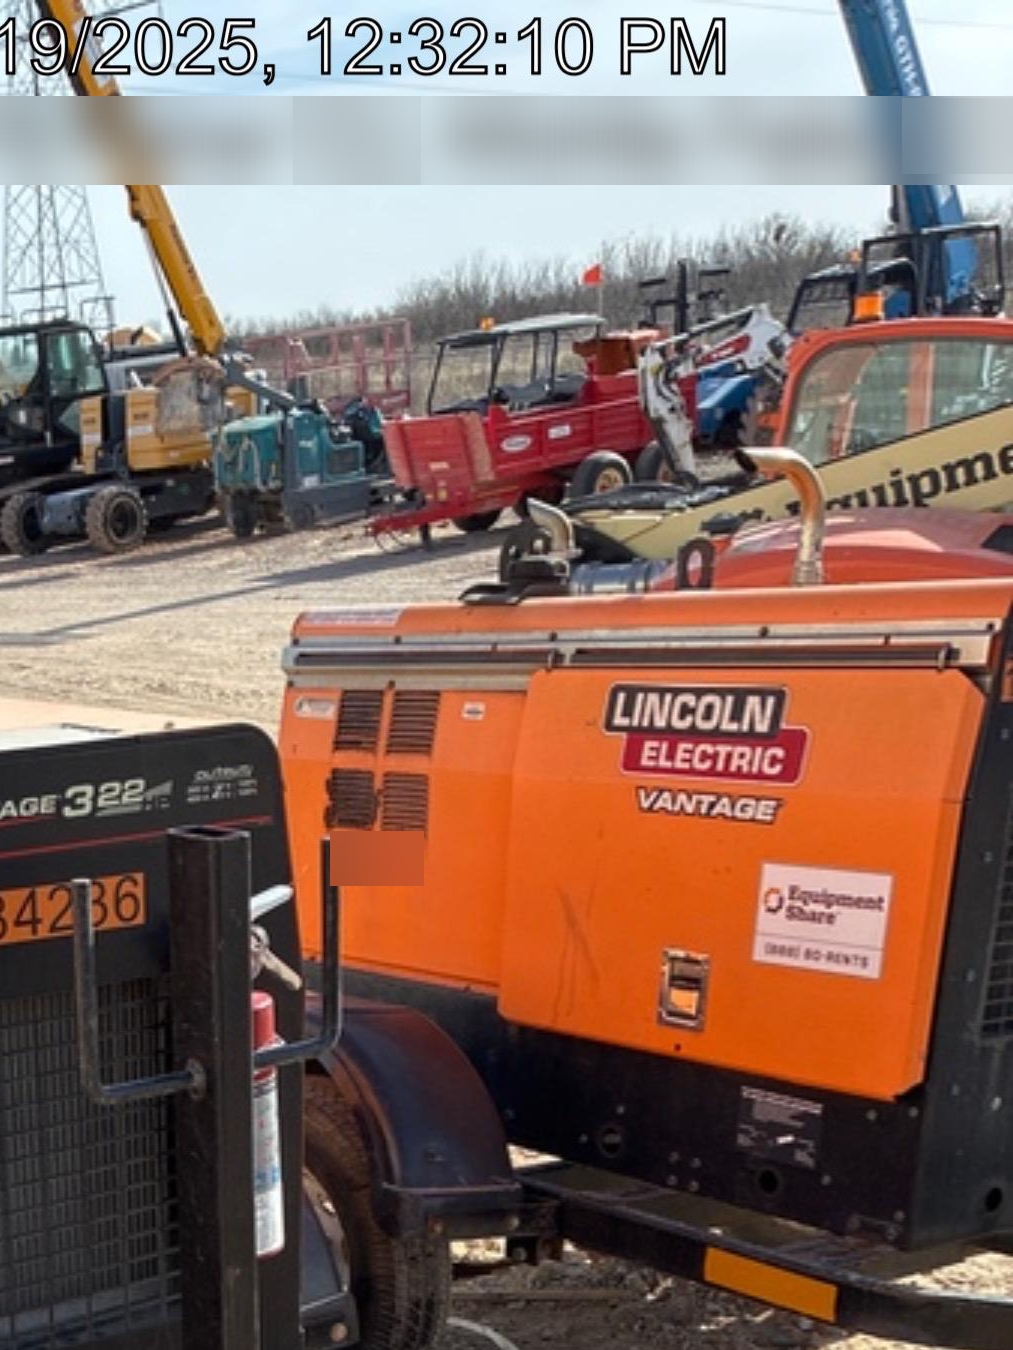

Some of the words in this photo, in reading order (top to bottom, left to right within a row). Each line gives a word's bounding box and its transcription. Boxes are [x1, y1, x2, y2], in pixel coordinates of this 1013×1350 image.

[612, 692, 776, 733] LINCOLN
[640, 740, 785, 775] ELECTRIC
[62, 778, 145, 818] 322
[637, 787, 781, 823] VANTAGE
[785, 904, 836, 925] Share
[788, 885, 885, 912] Equipment
